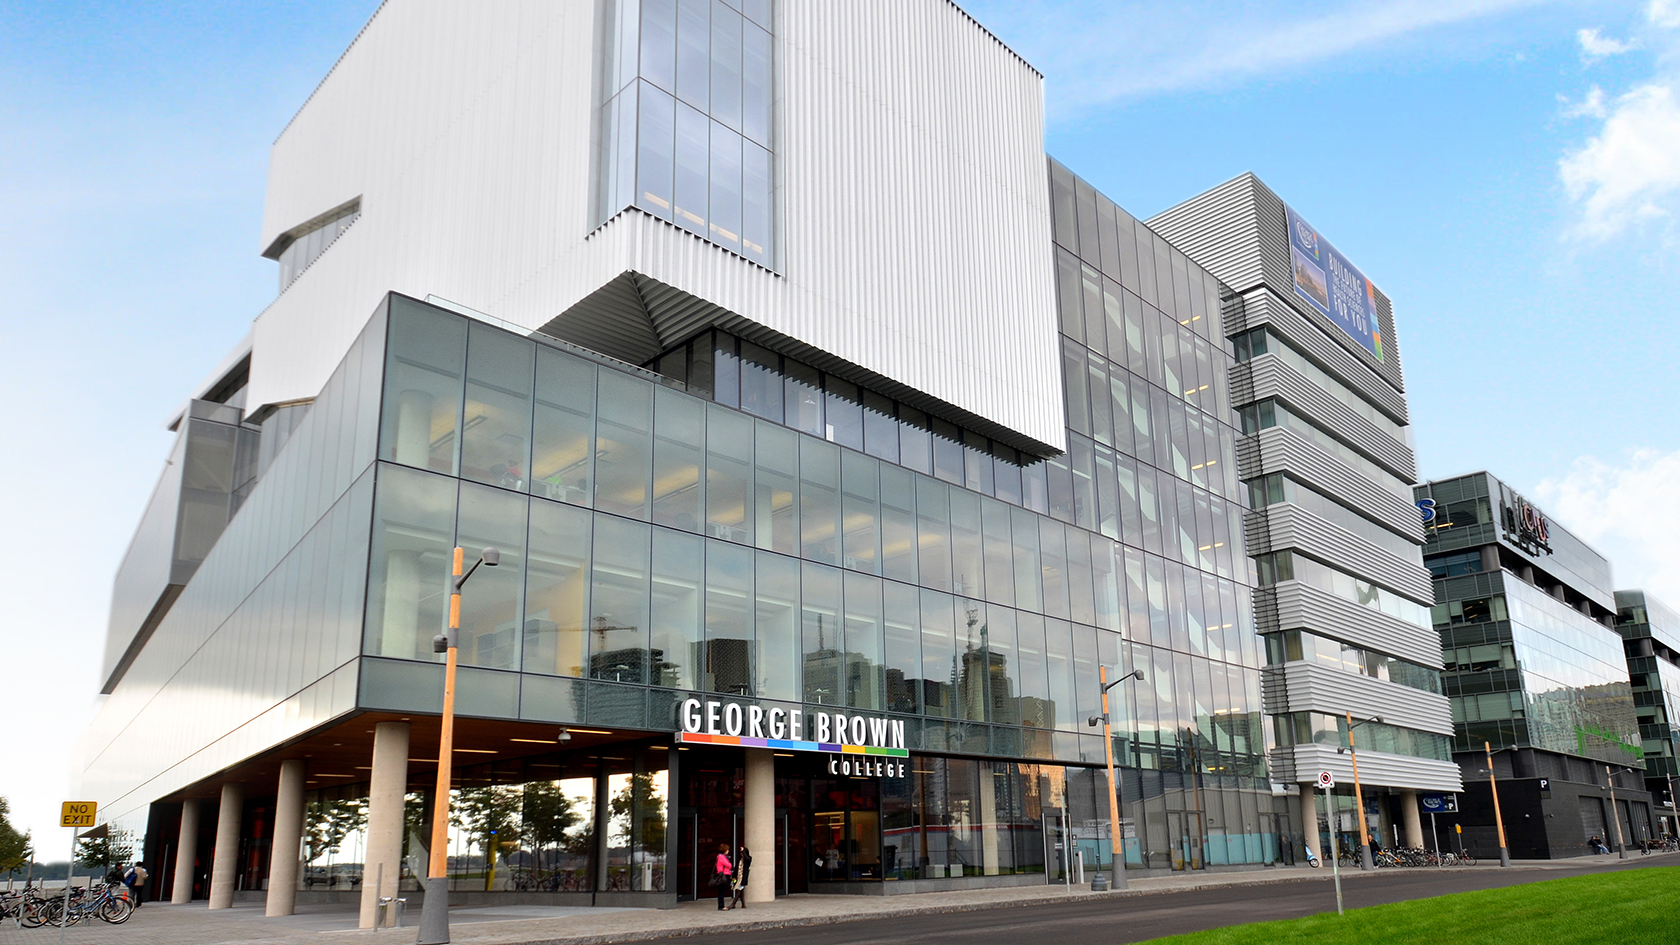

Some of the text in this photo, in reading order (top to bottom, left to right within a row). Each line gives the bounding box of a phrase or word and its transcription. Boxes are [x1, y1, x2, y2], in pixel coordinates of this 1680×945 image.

[1329, 253, 1363, 297] BUILDING
[1333, 294, 1368, 336] FOR YOU
[682, 698, 905, 749] GEORGE BROWN
[830, 759, 905, 778] COLLEGE
[1540, 780, 1548, 788] P
[70, 804, 88, 814] NO
[63, 815, 92, 824] EXIT
